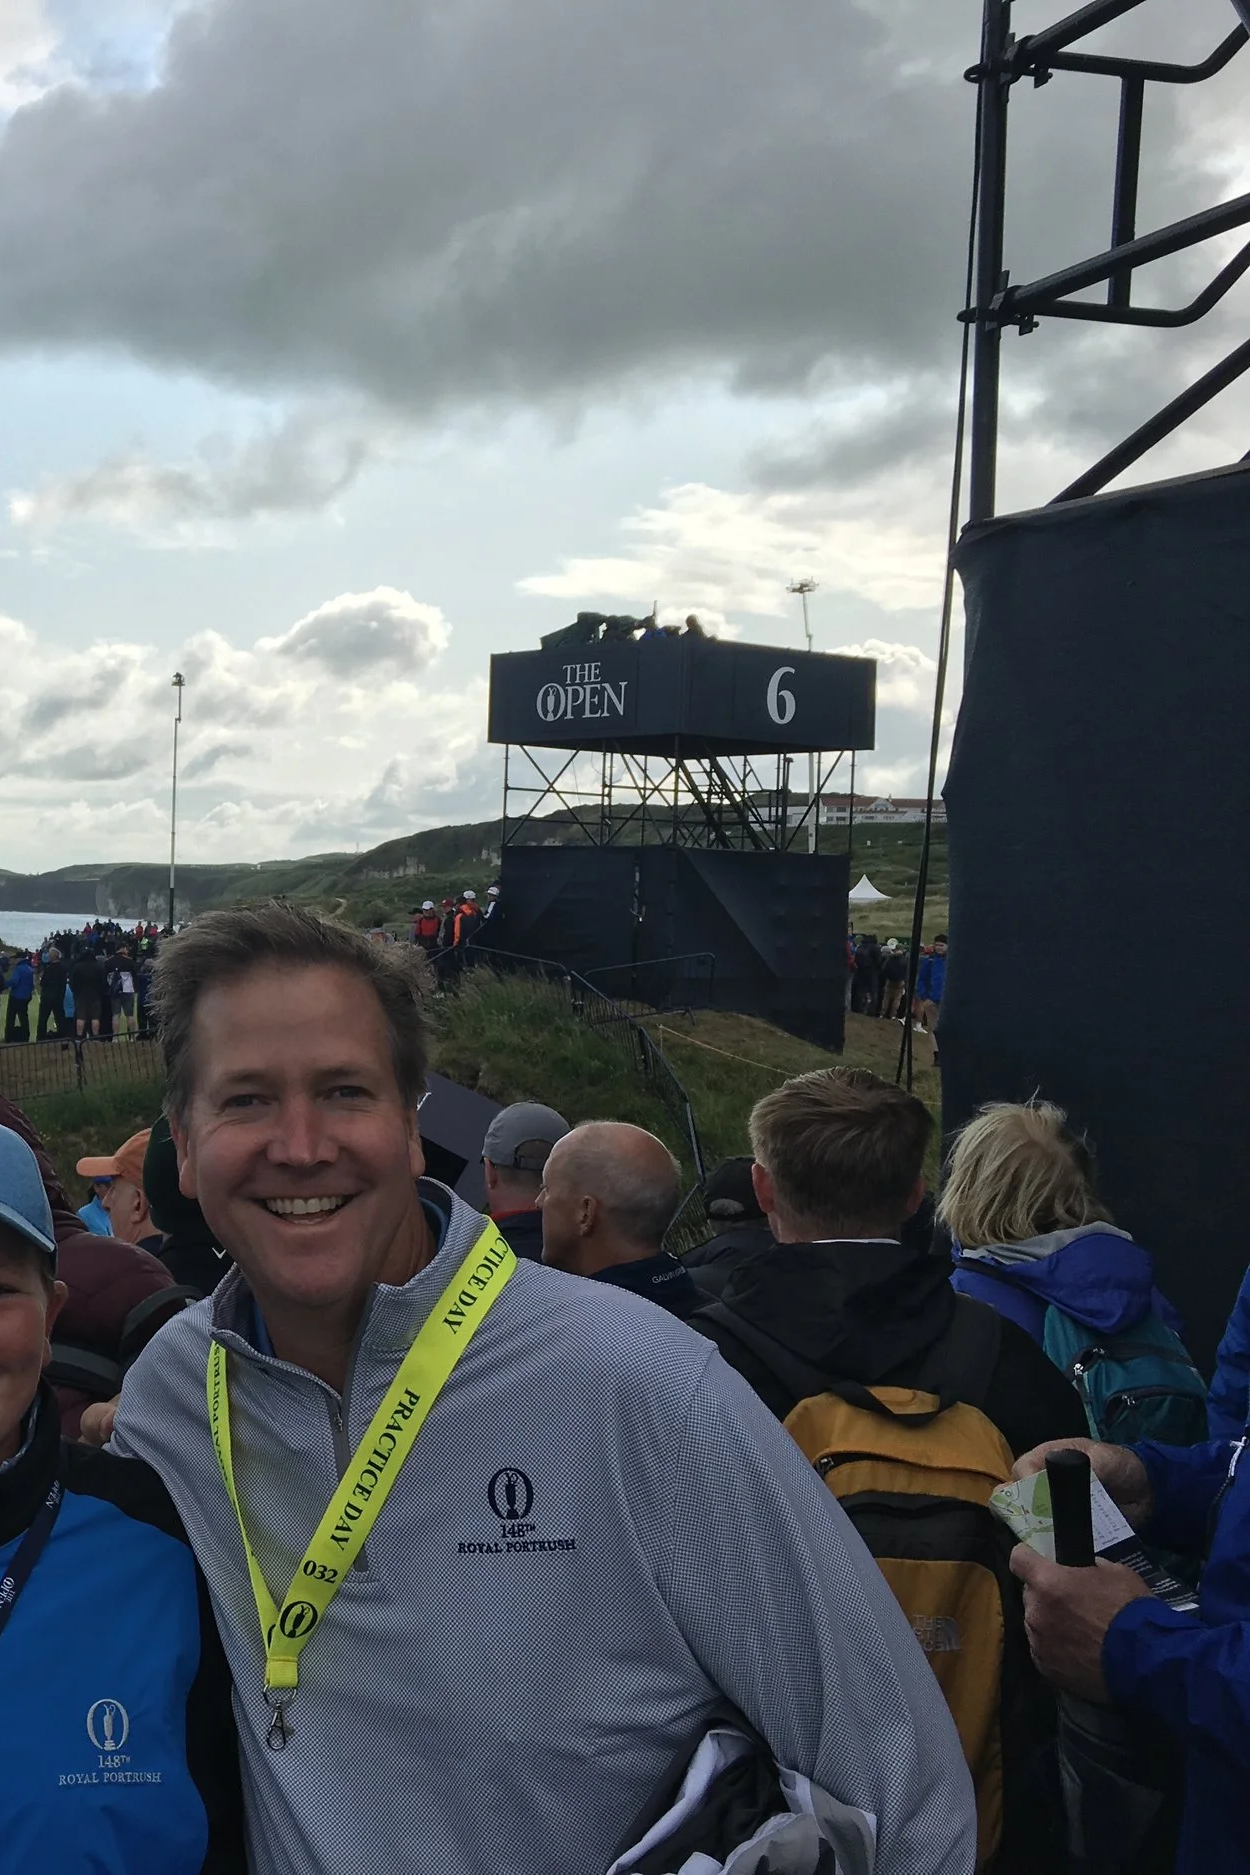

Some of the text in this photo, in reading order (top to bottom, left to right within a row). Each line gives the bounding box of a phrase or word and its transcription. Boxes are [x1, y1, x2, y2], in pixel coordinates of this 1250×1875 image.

[563, 662, 601, 684] THE
[537, 682, 628, 722] OPEN
[767, 667, 796, 725] 6
[442, 1236, 509, 1335] CTICE DAY
[212, 1342, 222, 1425] PORTRUS
[330, 1388, 420, 1551] PRACTICE DAY
[457, 1540, 577, 1554] ROYAL PORTRUSH
[303, 1560, 339, 1584] 032
[59, 1772, 162, 1786] ROYAL PORTRUSH
